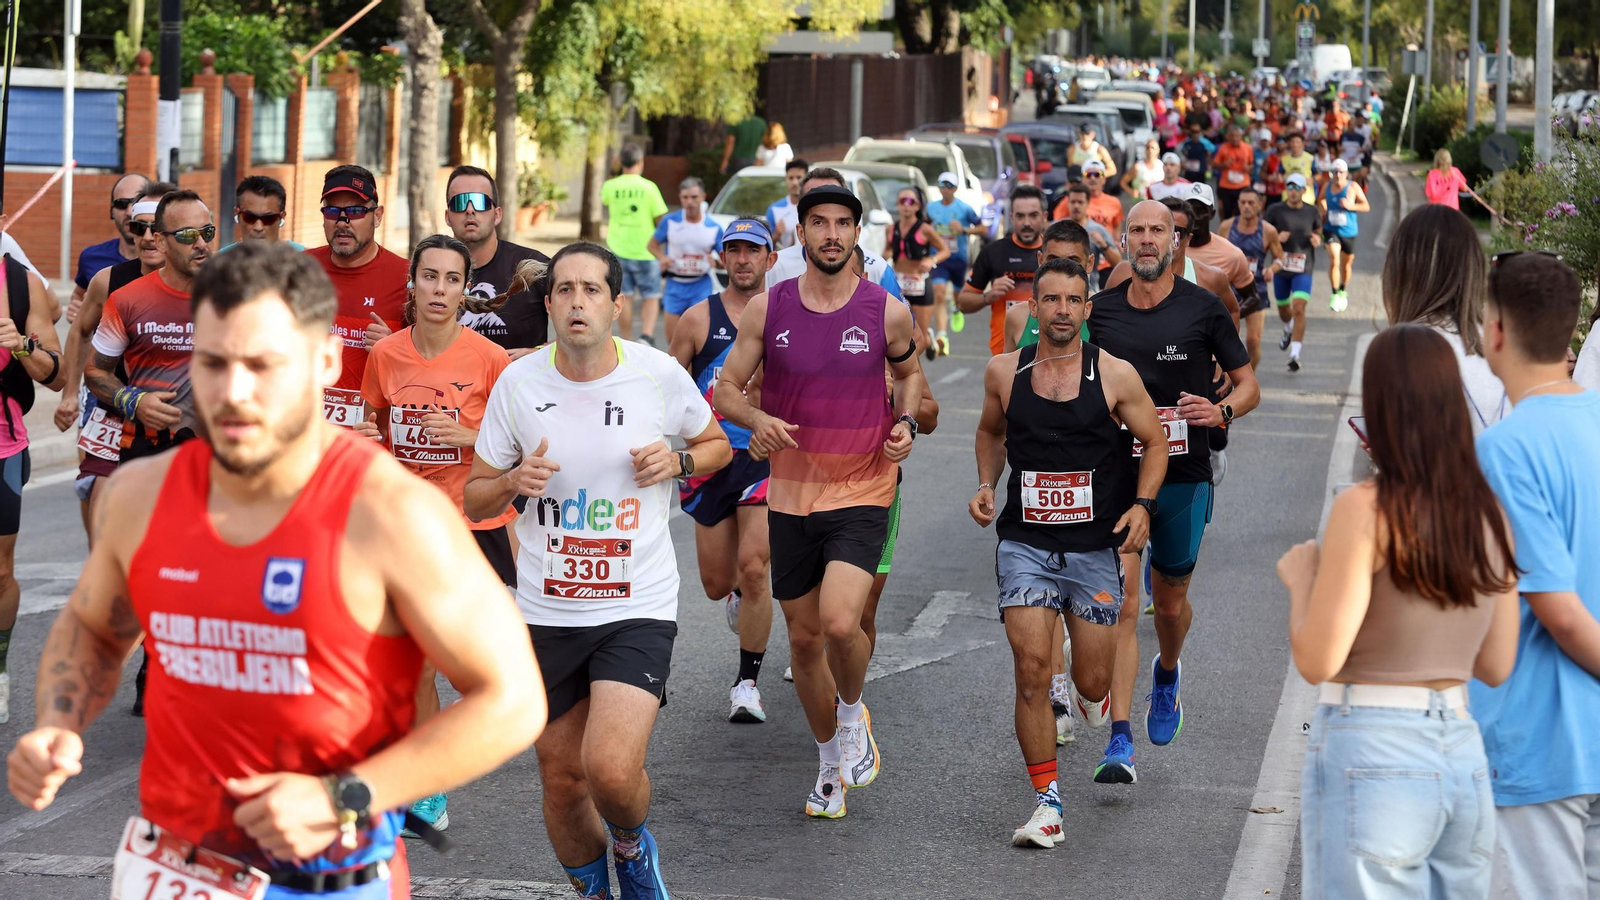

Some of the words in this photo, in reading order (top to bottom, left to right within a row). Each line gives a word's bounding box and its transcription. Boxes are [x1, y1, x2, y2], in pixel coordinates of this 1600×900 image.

[144, 321, 184, 334] Media
[152, 335, 184, 344] Ciudad
[324, 404, 347, 422] 73
[405, 427, 441, 446] 46
[1038, 490, 1075, 507] 508
[563, 558, 610, 580] 330
[150, 611, 196, 645] CLUB
[199, 617, 307, 655] ATLETISMO
